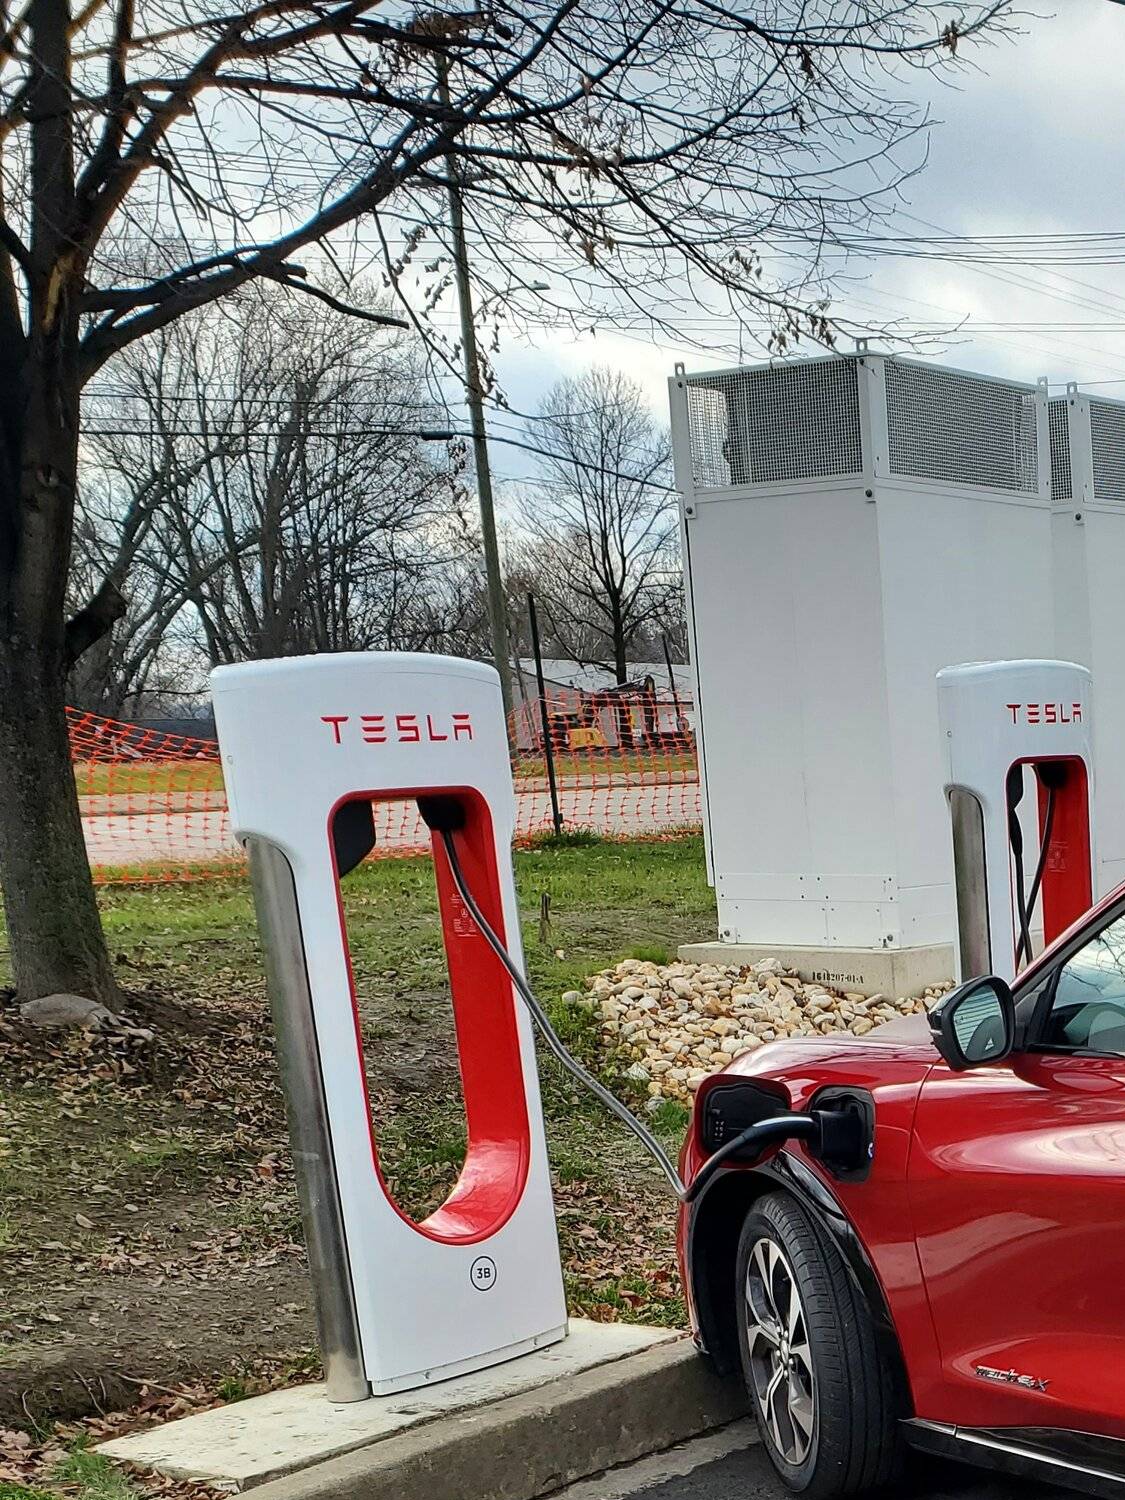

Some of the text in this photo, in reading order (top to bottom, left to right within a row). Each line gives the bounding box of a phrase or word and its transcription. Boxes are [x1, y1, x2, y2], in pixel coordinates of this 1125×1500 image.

[1006, 703, 1082, 724] TESLA
[320, 714, 474, 744] TESLA
[477, 1267, 491, 1279] 3B
